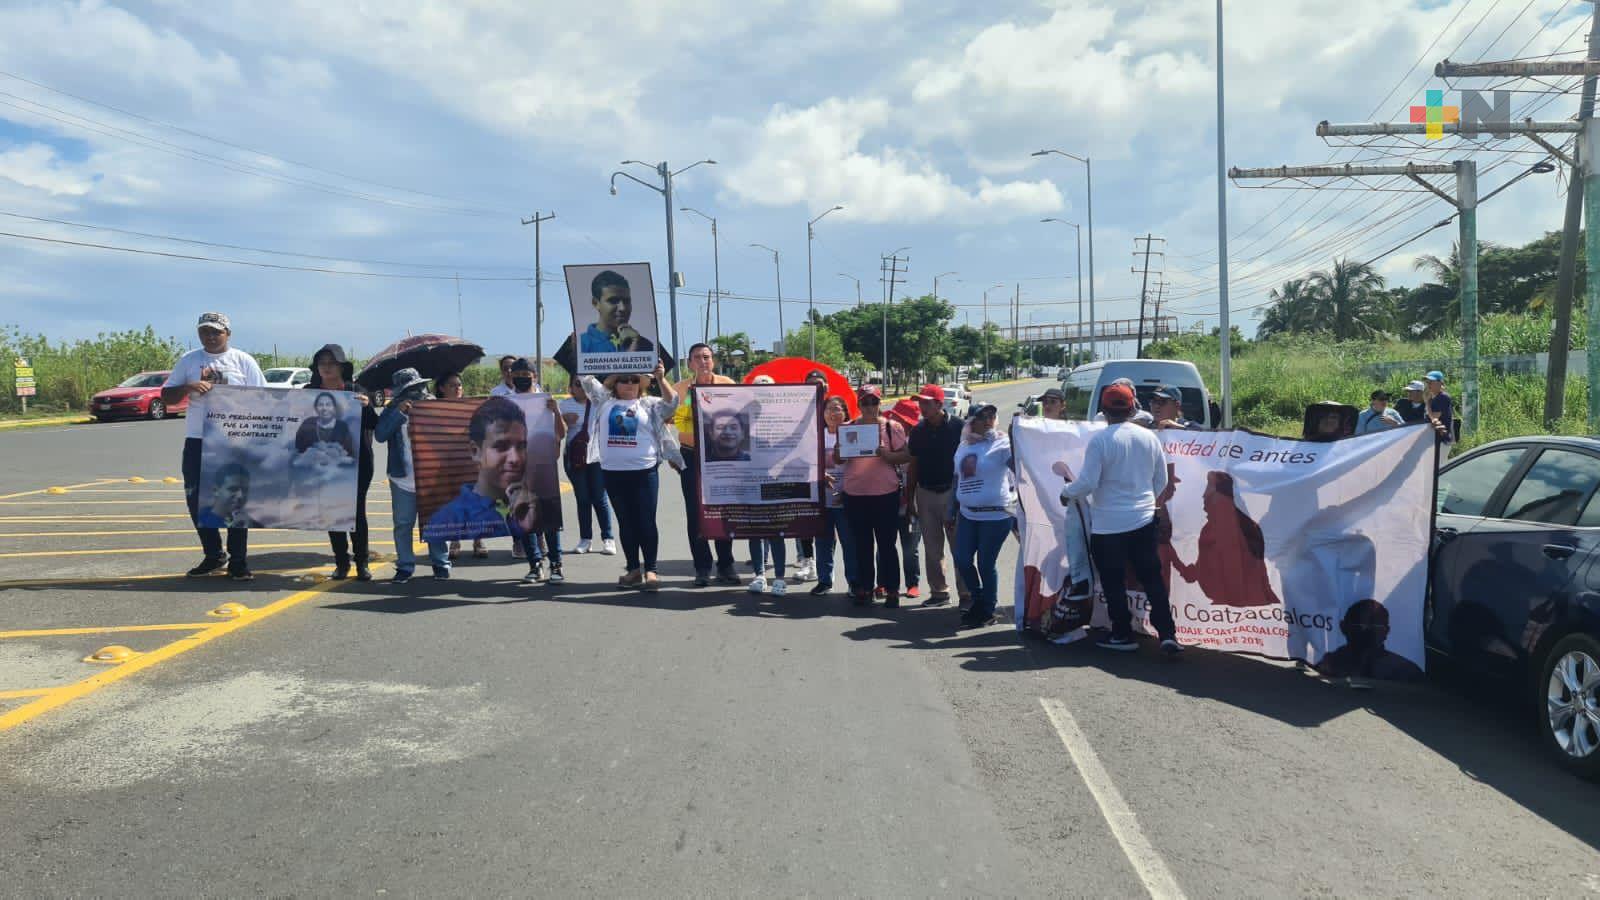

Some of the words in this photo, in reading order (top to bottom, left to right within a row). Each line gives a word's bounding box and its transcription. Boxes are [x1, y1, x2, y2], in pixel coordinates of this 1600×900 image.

[583, 363, 611, 371] TORRES
[206, 411, 226, 420] HIJO
[227, 430, 279, 438] ENCONTRARTE
[1218, 439, 1243, 459] de
[1249, 448, 1318, 464] antes
[1184, 602, 1333, 632] Coatzacoalcos
[1205, 624, 1292, 638] COATZACOALCOS
[1224, 636, 1239, 645] DE
